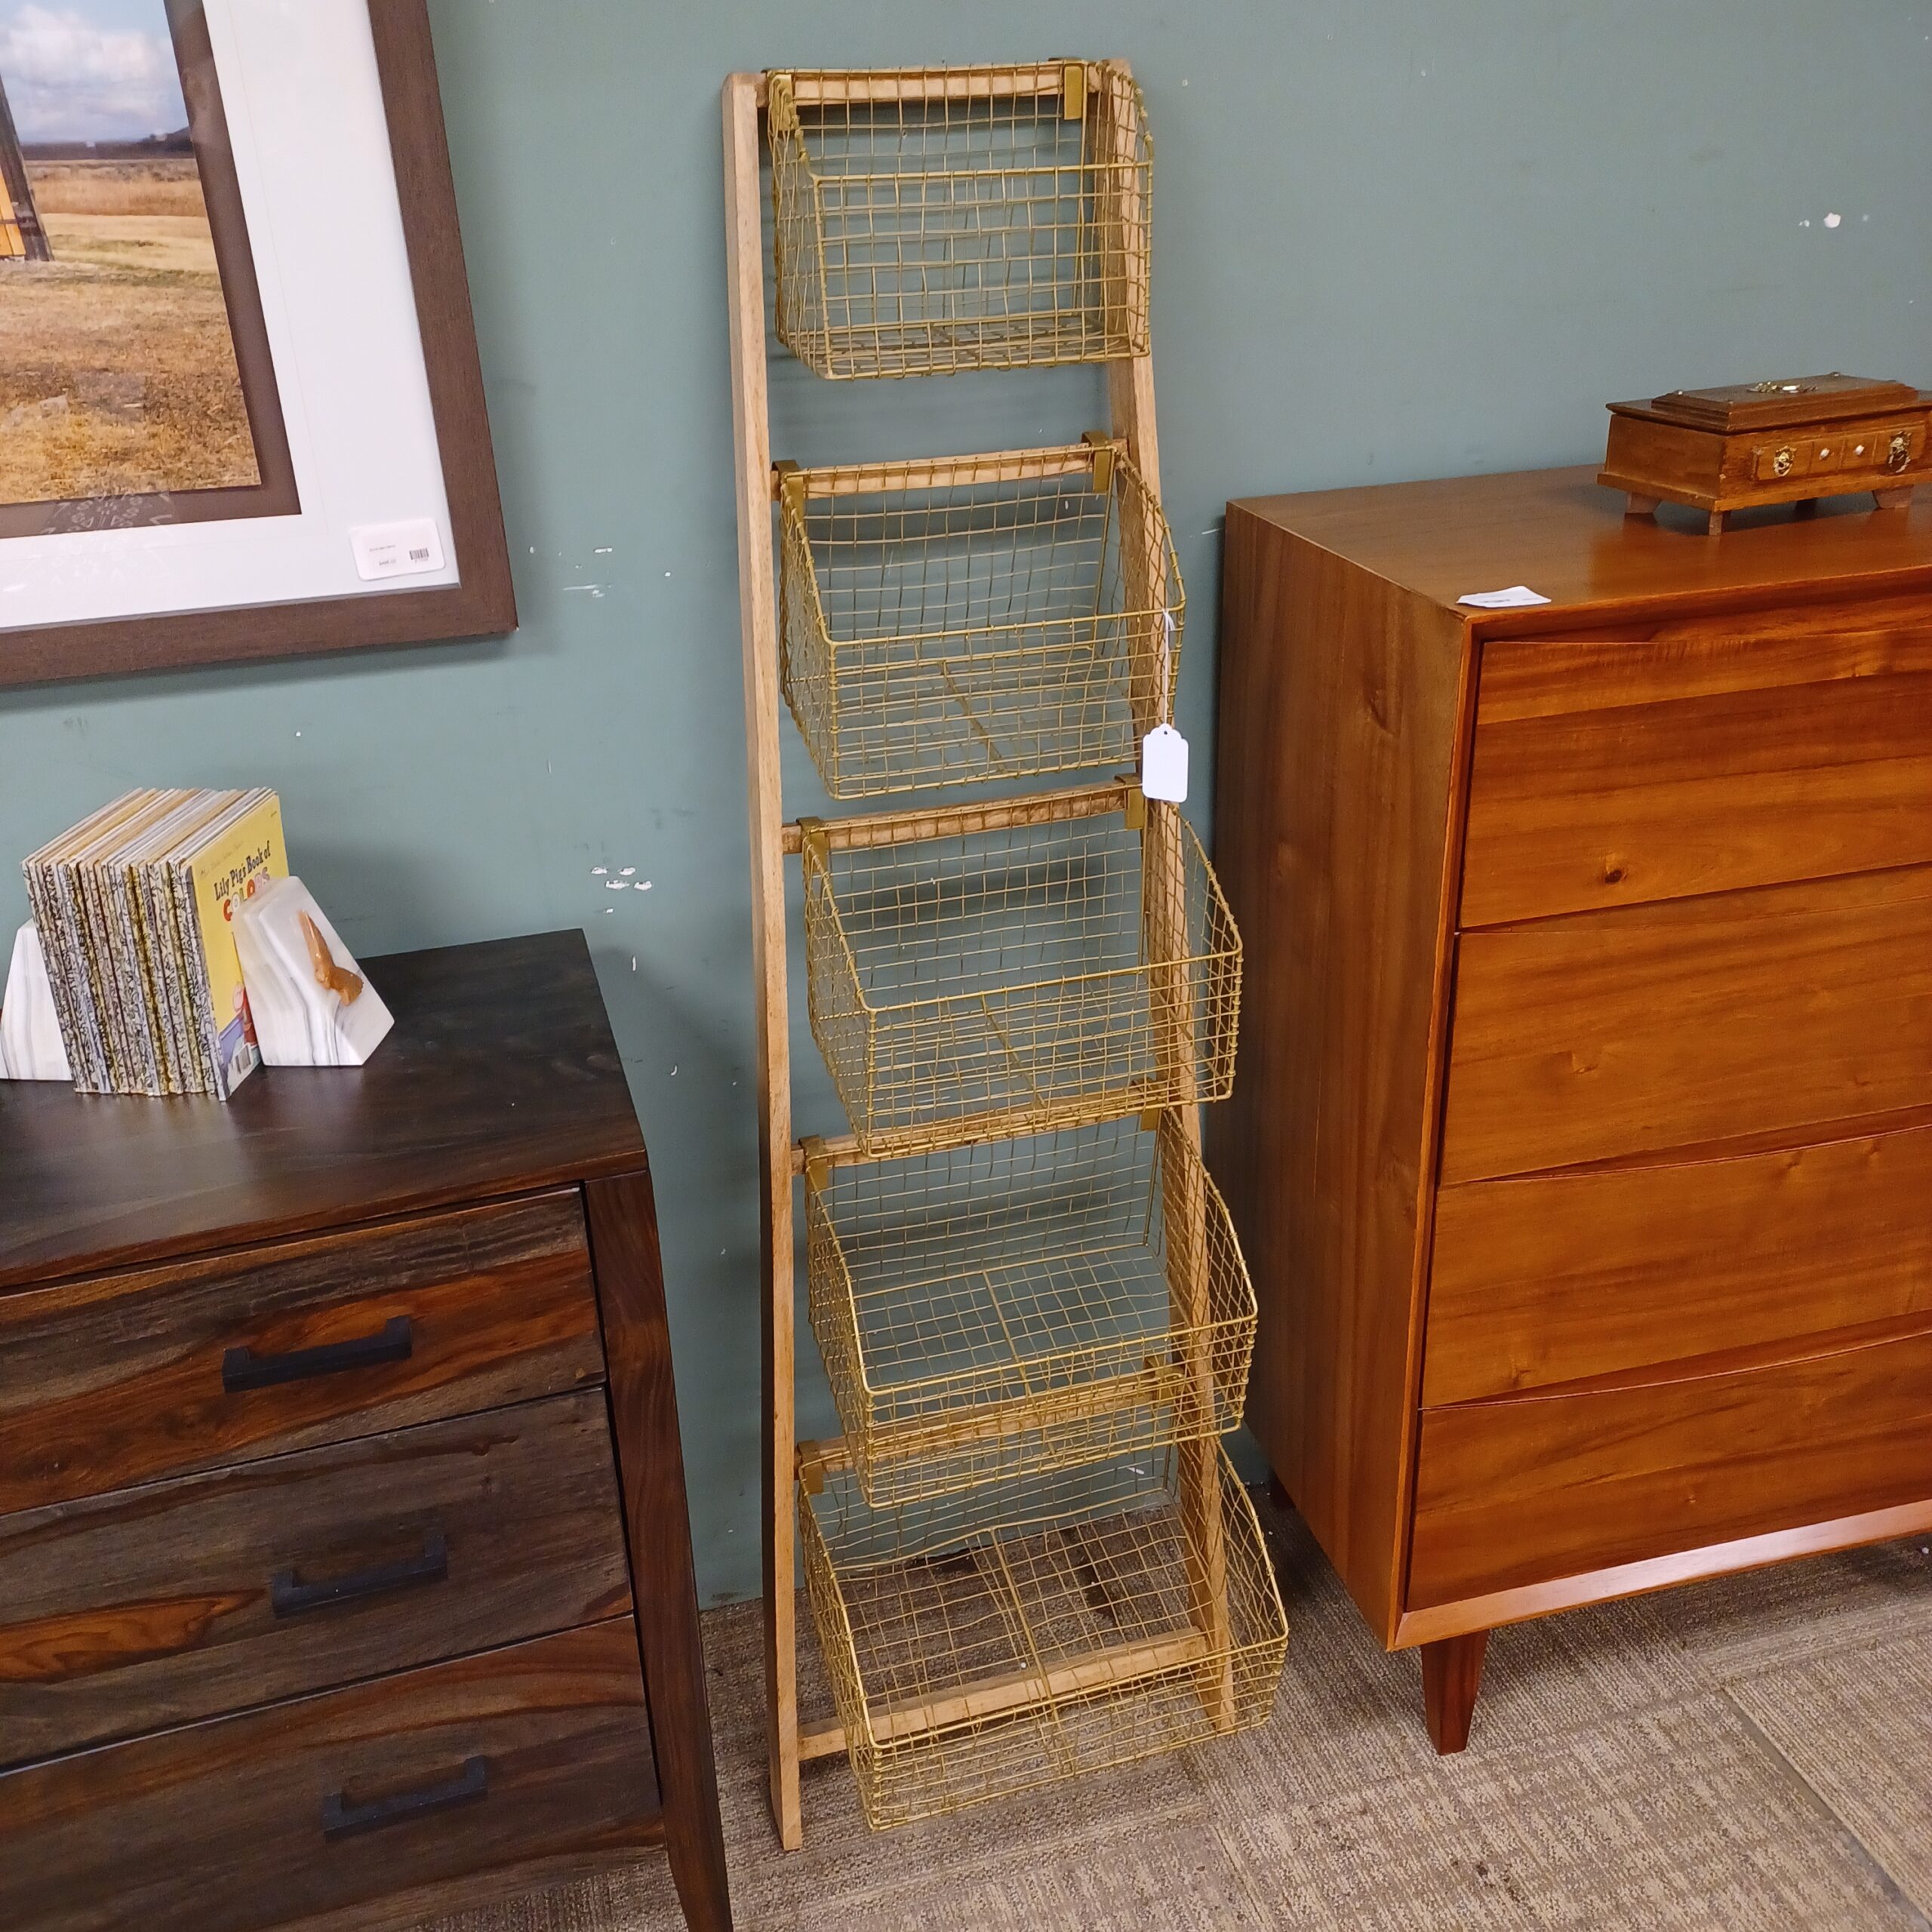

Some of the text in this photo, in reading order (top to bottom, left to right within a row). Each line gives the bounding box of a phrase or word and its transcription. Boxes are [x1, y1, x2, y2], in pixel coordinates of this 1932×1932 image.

[214, 877, 229, 901] Lily
[229, 863, 247, 888] Pig's
[246, 848, 264, 874] Book
[264, 840, 271, 860] of
